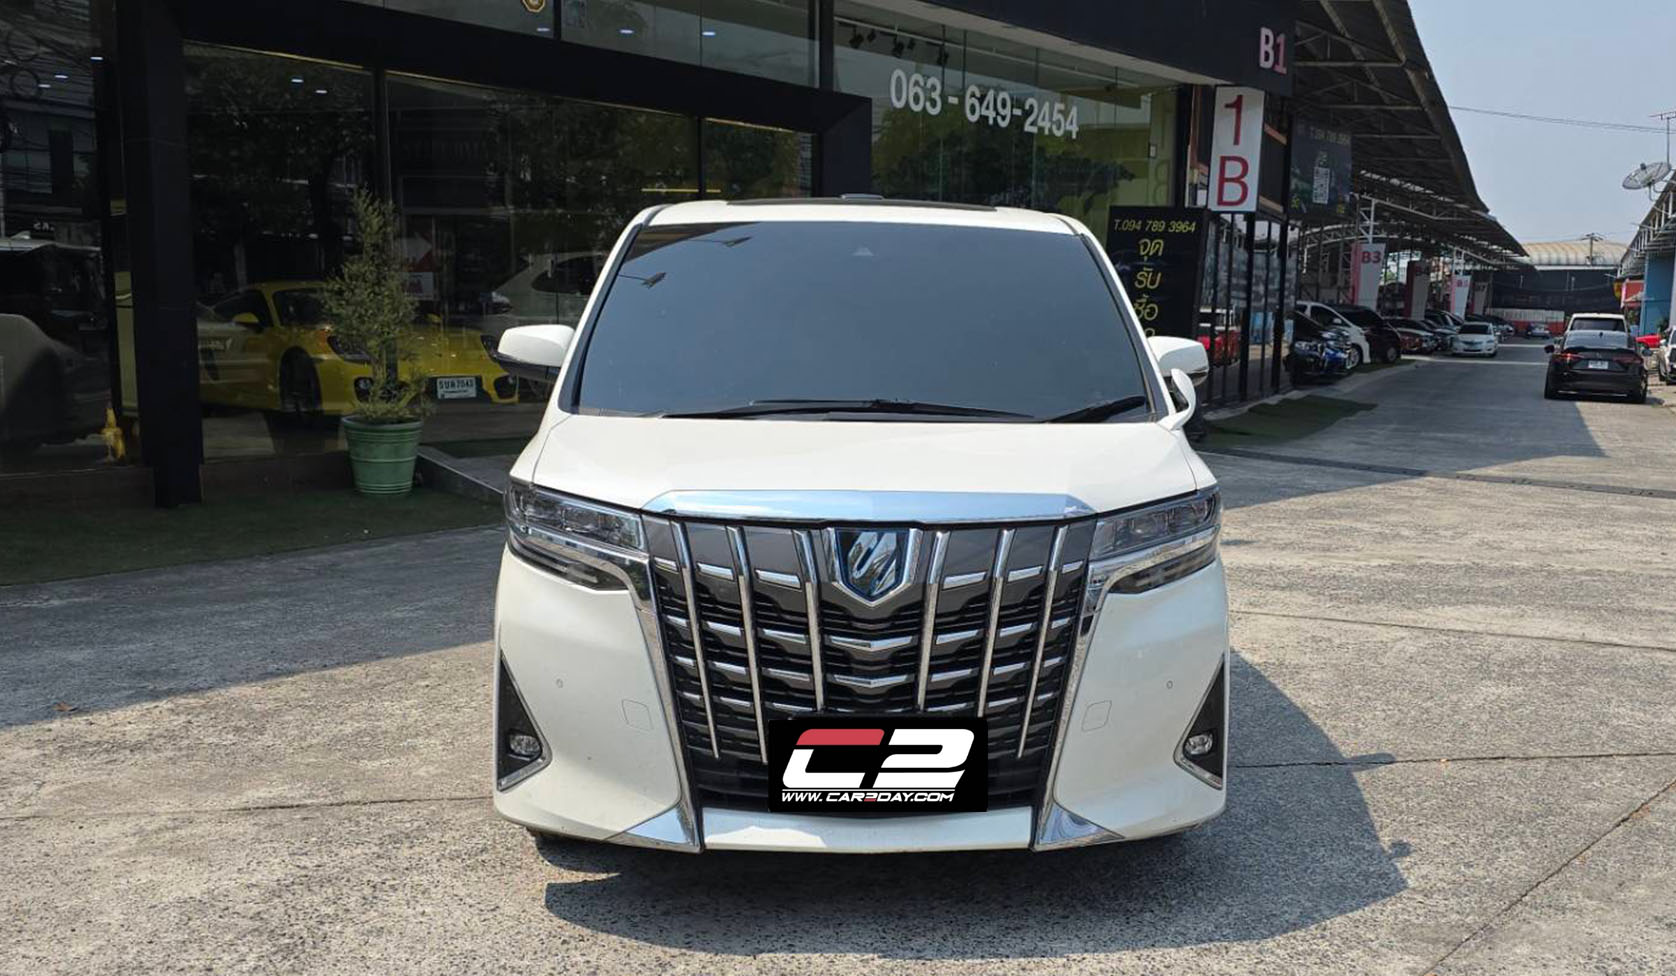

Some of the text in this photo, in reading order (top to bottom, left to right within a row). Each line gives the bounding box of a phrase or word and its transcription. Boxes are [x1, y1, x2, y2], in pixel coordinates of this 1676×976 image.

[1260, 27, 1287, 75] B1
[1145, 220, 1166, 232] 789
[1168, 221, 1196, 232] 3964
[1138, 238, 1164, 262] จุด
[1361, 251, 1382, 264] B3
[1134, 267, 1161, 289] รับ
